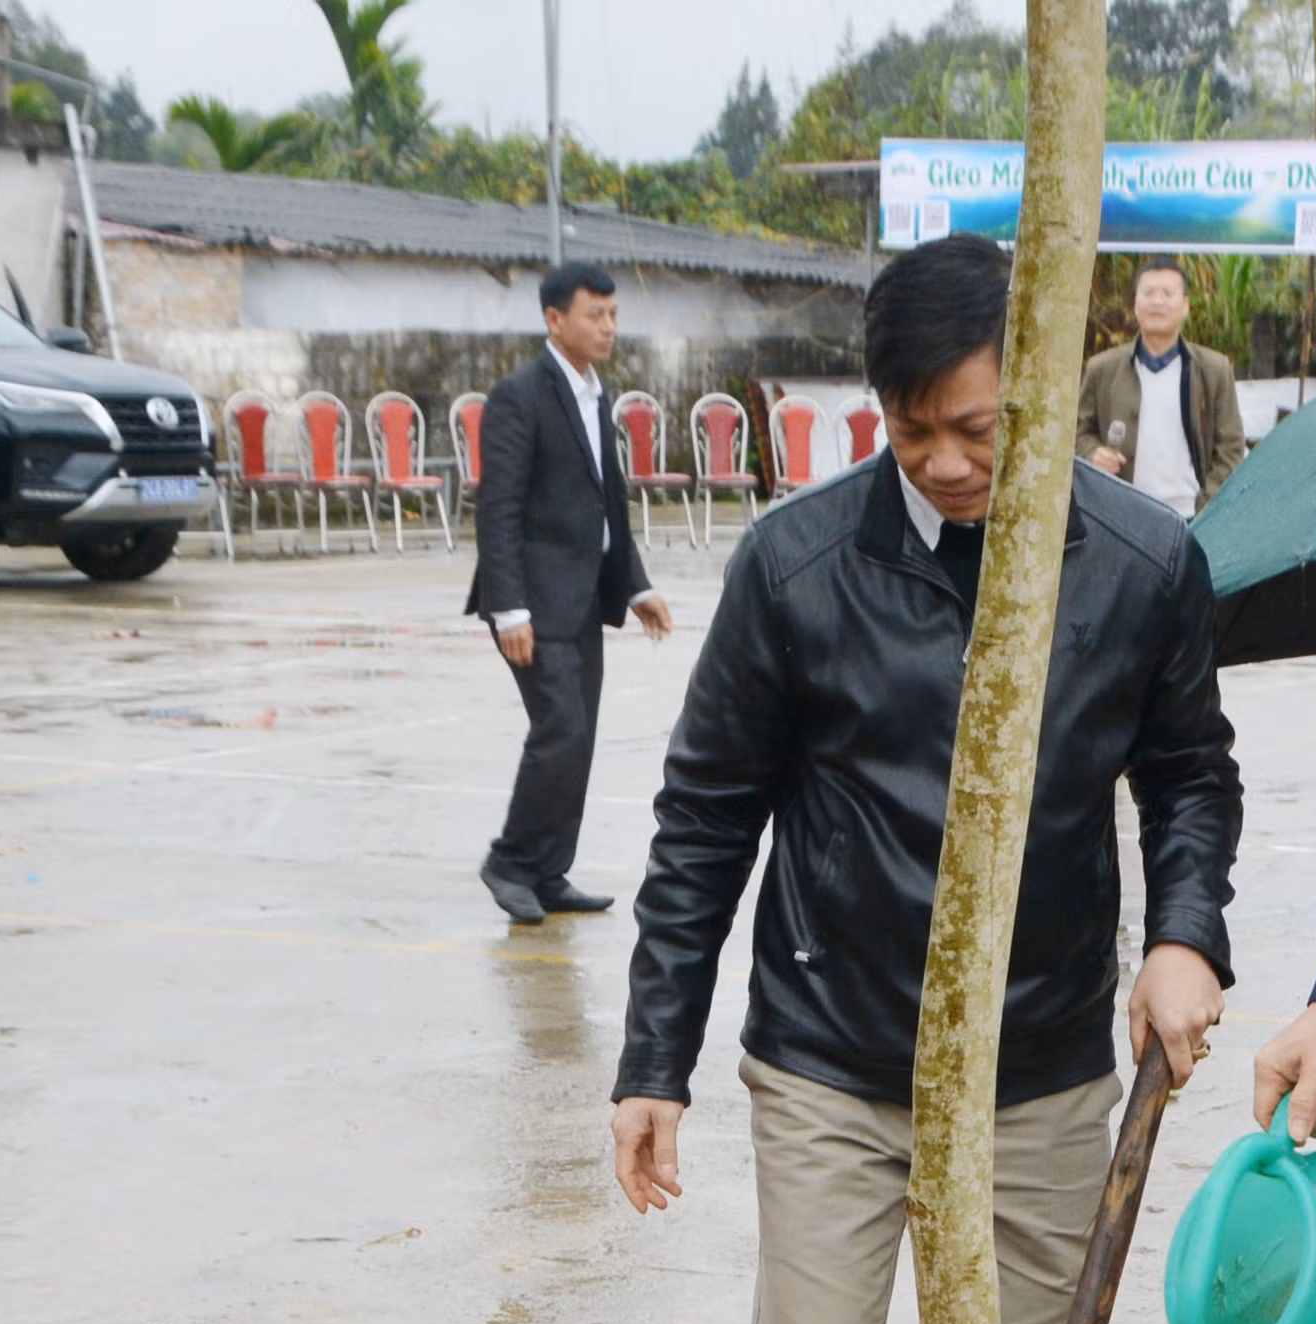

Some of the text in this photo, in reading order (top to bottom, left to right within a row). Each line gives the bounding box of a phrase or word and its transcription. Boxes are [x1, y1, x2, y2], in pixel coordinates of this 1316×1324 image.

[927, 159, 982, 188] Gieo
[1134, 158, 1197, 189] Toàn
[1205, 157, 1254, 190] Cầu
